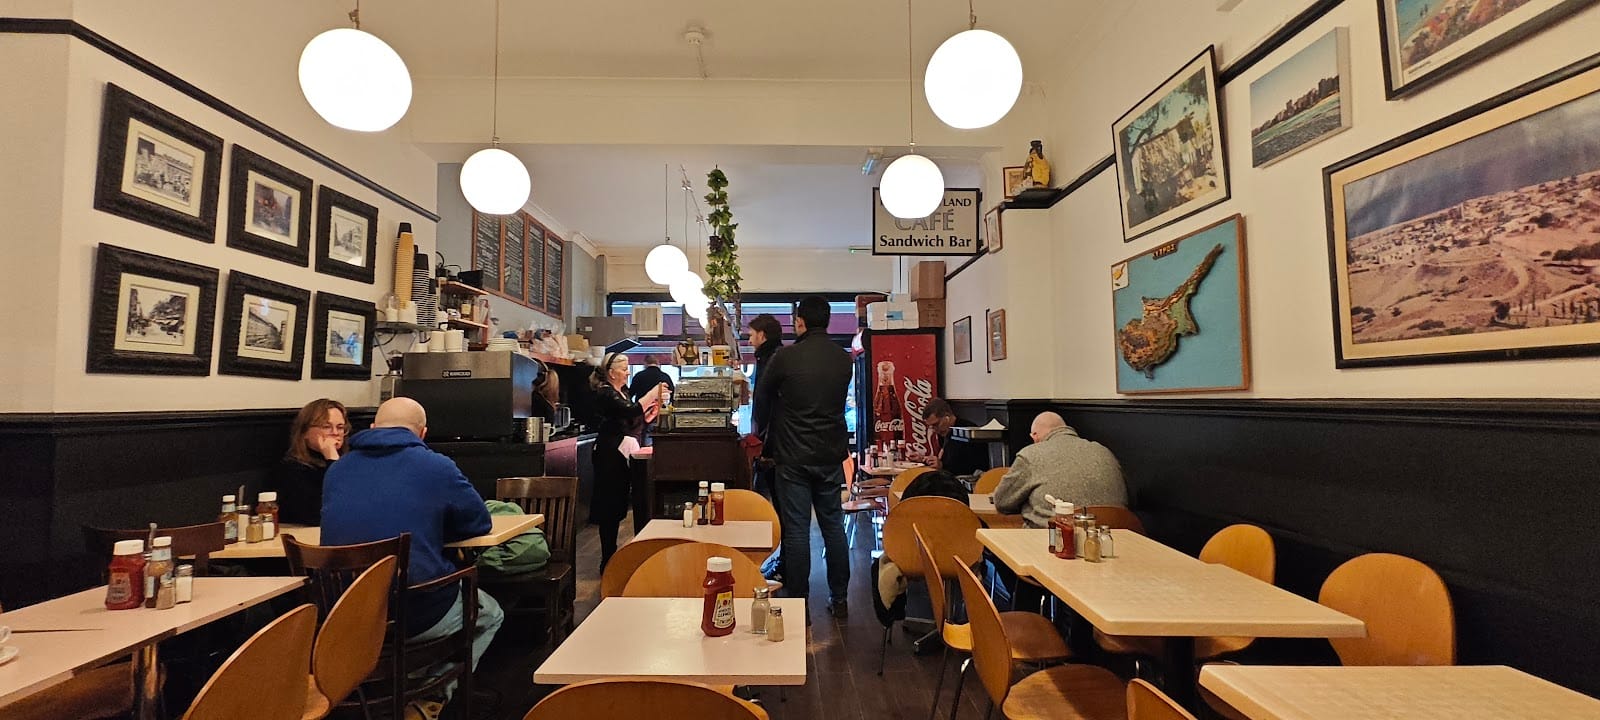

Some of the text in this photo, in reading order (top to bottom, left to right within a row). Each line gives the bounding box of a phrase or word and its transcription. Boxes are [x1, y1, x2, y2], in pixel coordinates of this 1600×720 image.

[894, 208, 954, 231] CAFÉ
[879, 234, 972, 247] Sandwich Bar
